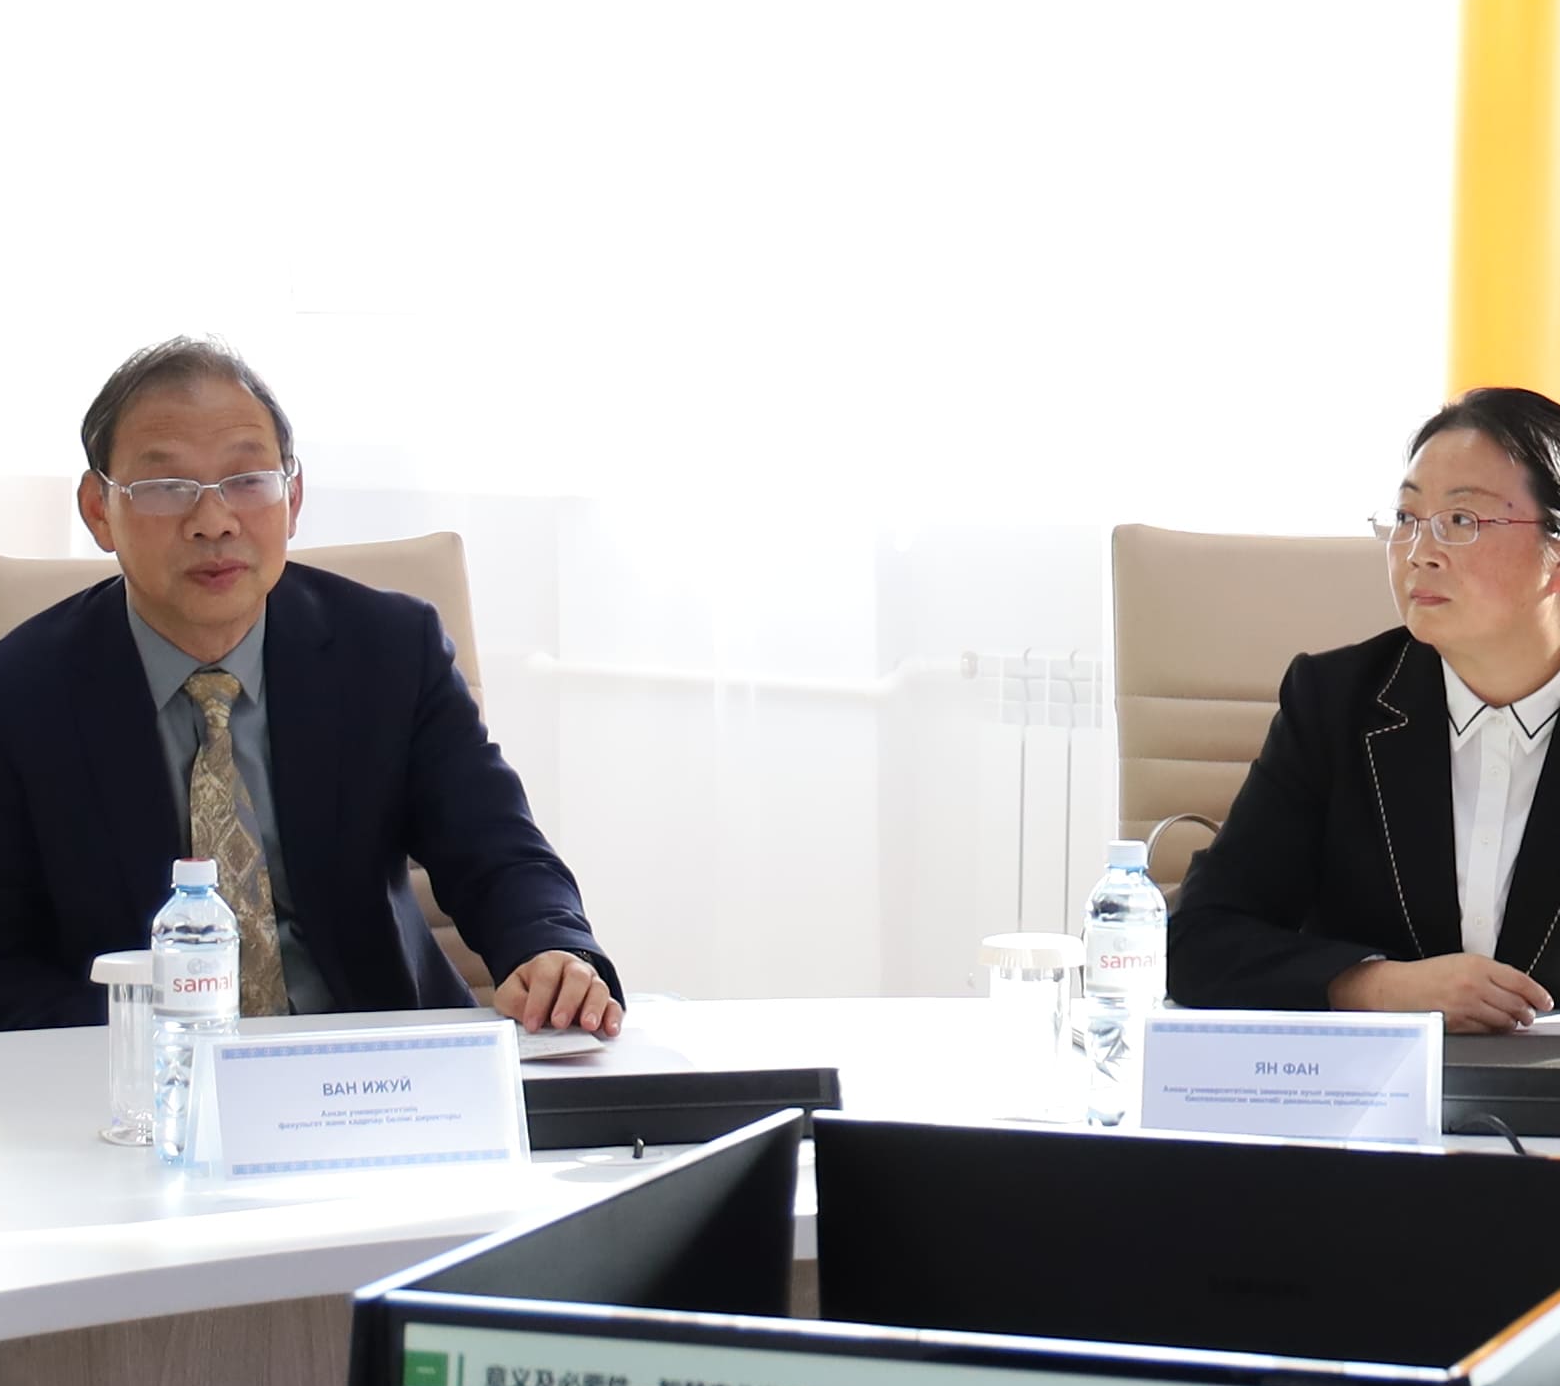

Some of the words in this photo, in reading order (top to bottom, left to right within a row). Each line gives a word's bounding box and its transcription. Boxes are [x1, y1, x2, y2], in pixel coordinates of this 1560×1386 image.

[1100, 950, 1156, 969] samal
[173, 969, 232, 993] samal
[1255, 1061, 1278, 1075] ЯН
[1282, 1062, 1320, 1076] ФАН
[323, 1081, 357, 1097] ВАН
[362, 1075, 412, 1095] ИЖУЙ
